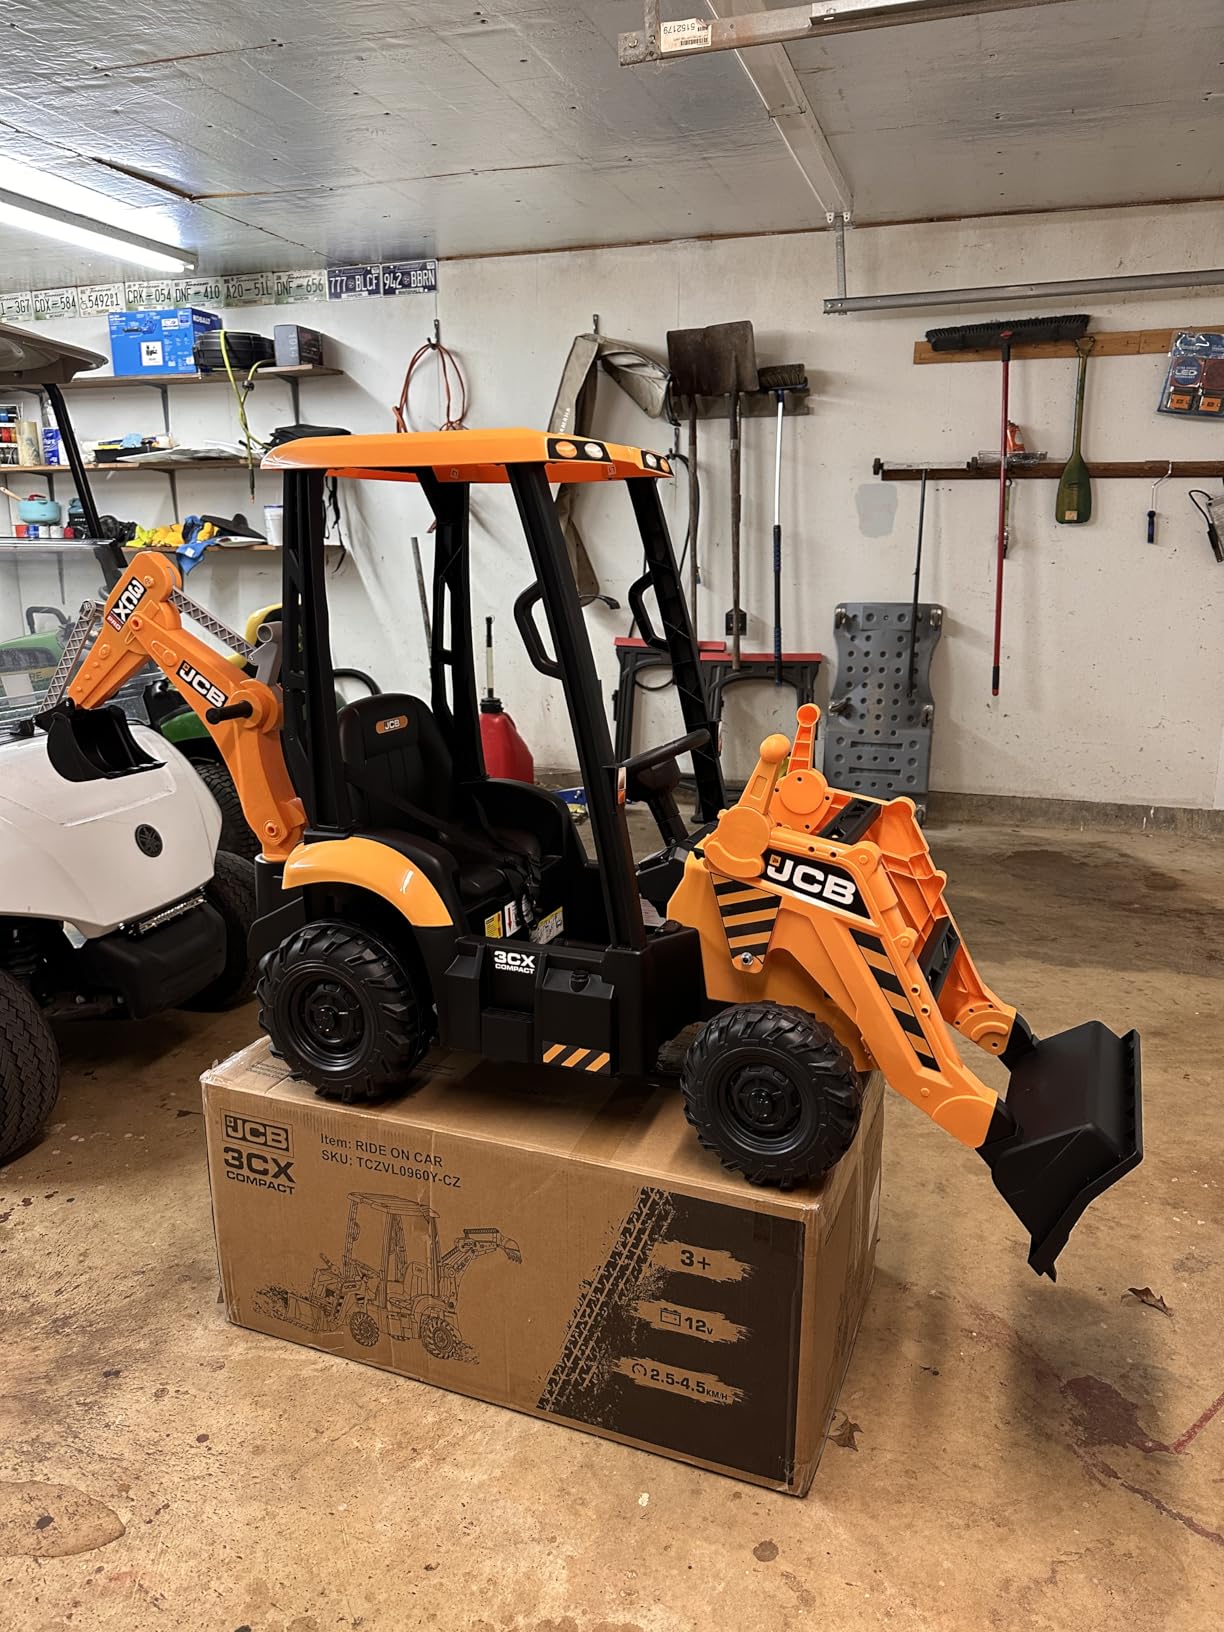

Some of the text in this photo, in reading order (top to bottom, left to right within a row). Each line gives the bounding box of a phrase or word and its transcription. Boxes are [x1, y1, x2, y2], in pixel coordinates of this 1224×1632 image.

[329, 273, 379, 293] 777 BLCF
[383, 269, 435, 289] 942 BBRN
[179, 663, 227, 708] JCB
[384, 719, 400, 730] JCB
[766, 858, 856, 905] JCB
[494, 950, 536, 968] 3CX
[495, 963, 535, 974] COMPACT
[226, 1117, 289, 1150] JCB
[320, 1133, 443, 1167] Item: RIDE ON CAR
[223, 1146, 296, 1184] 3CX
[321, 1149, 461, 1188] SKU: TCZVL0960Y-CZ
[226, 1170, 295, 1195] COMPACT
[680, 1249, 711, 1270] 3+
